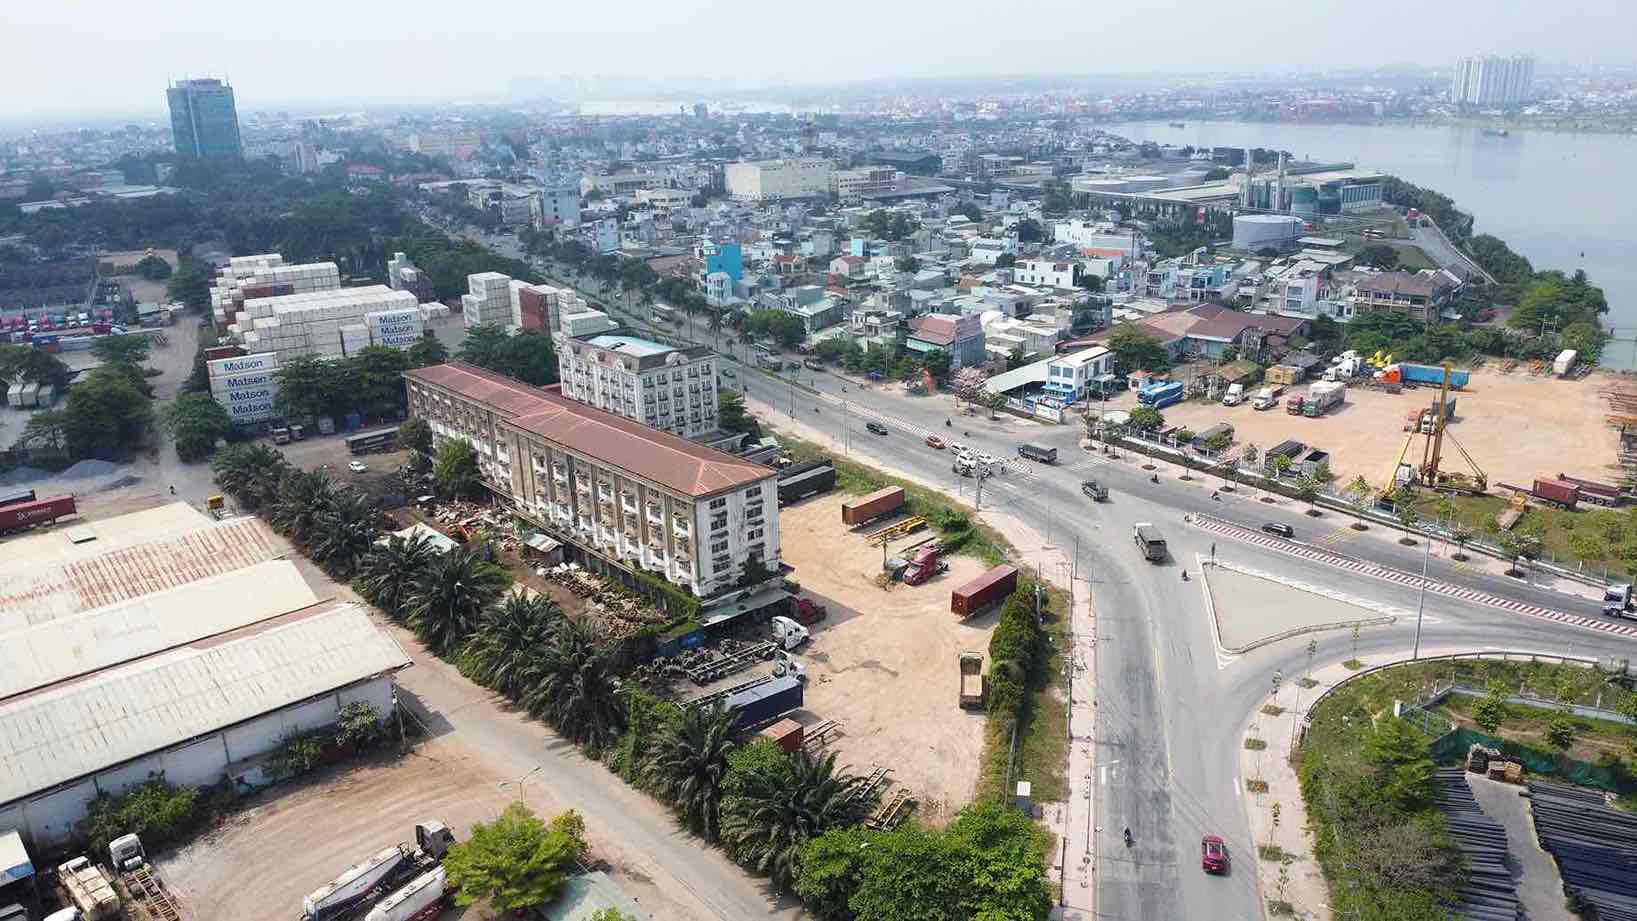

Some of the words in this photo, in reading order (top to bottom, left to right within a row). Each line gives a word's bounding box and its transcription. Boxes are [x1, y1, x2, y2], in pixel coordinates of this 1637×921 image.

[223, 360, 263, 371] Matson
[227, 376, 267, 388] Matson
[230, 390, 269, 401] Matson
[232, 403, 272, 415] Matson
